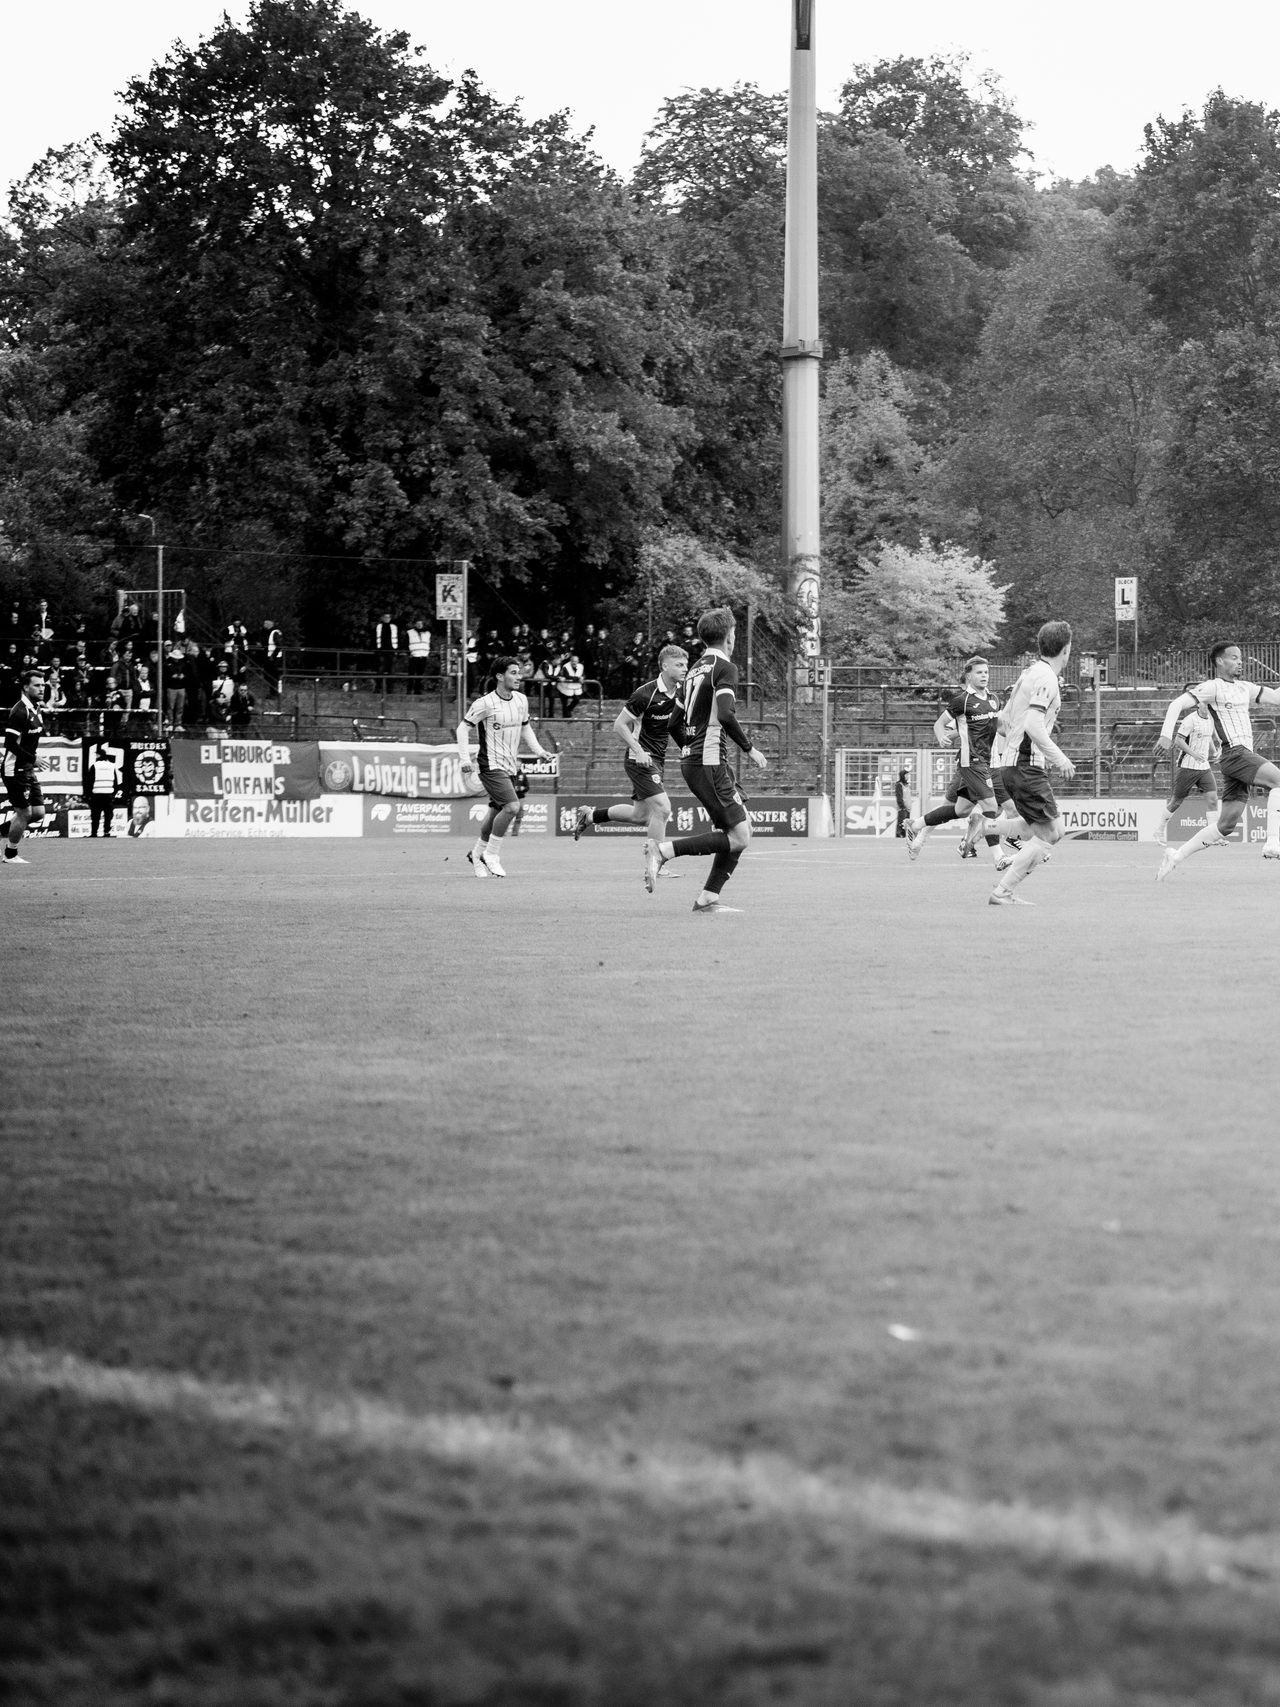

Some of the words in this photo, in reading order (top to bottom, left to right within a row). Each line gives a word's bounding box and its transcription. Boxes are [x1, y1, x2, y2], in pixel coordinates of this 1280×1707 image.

[1121, 588, 1130, 605] L
[904, 758, 912, 771] 5
[936, 758, 945, 771] 6
[186, 800, 333, 823] Reifen-Müller
[395, 803, 452, 813] TAVERPACK
[1062, 808, 1137, 828] TADTGRÜN
[1180, 817, 1206, 828] mbs.de
[1088, 832, 1116, 842] Potsdam
